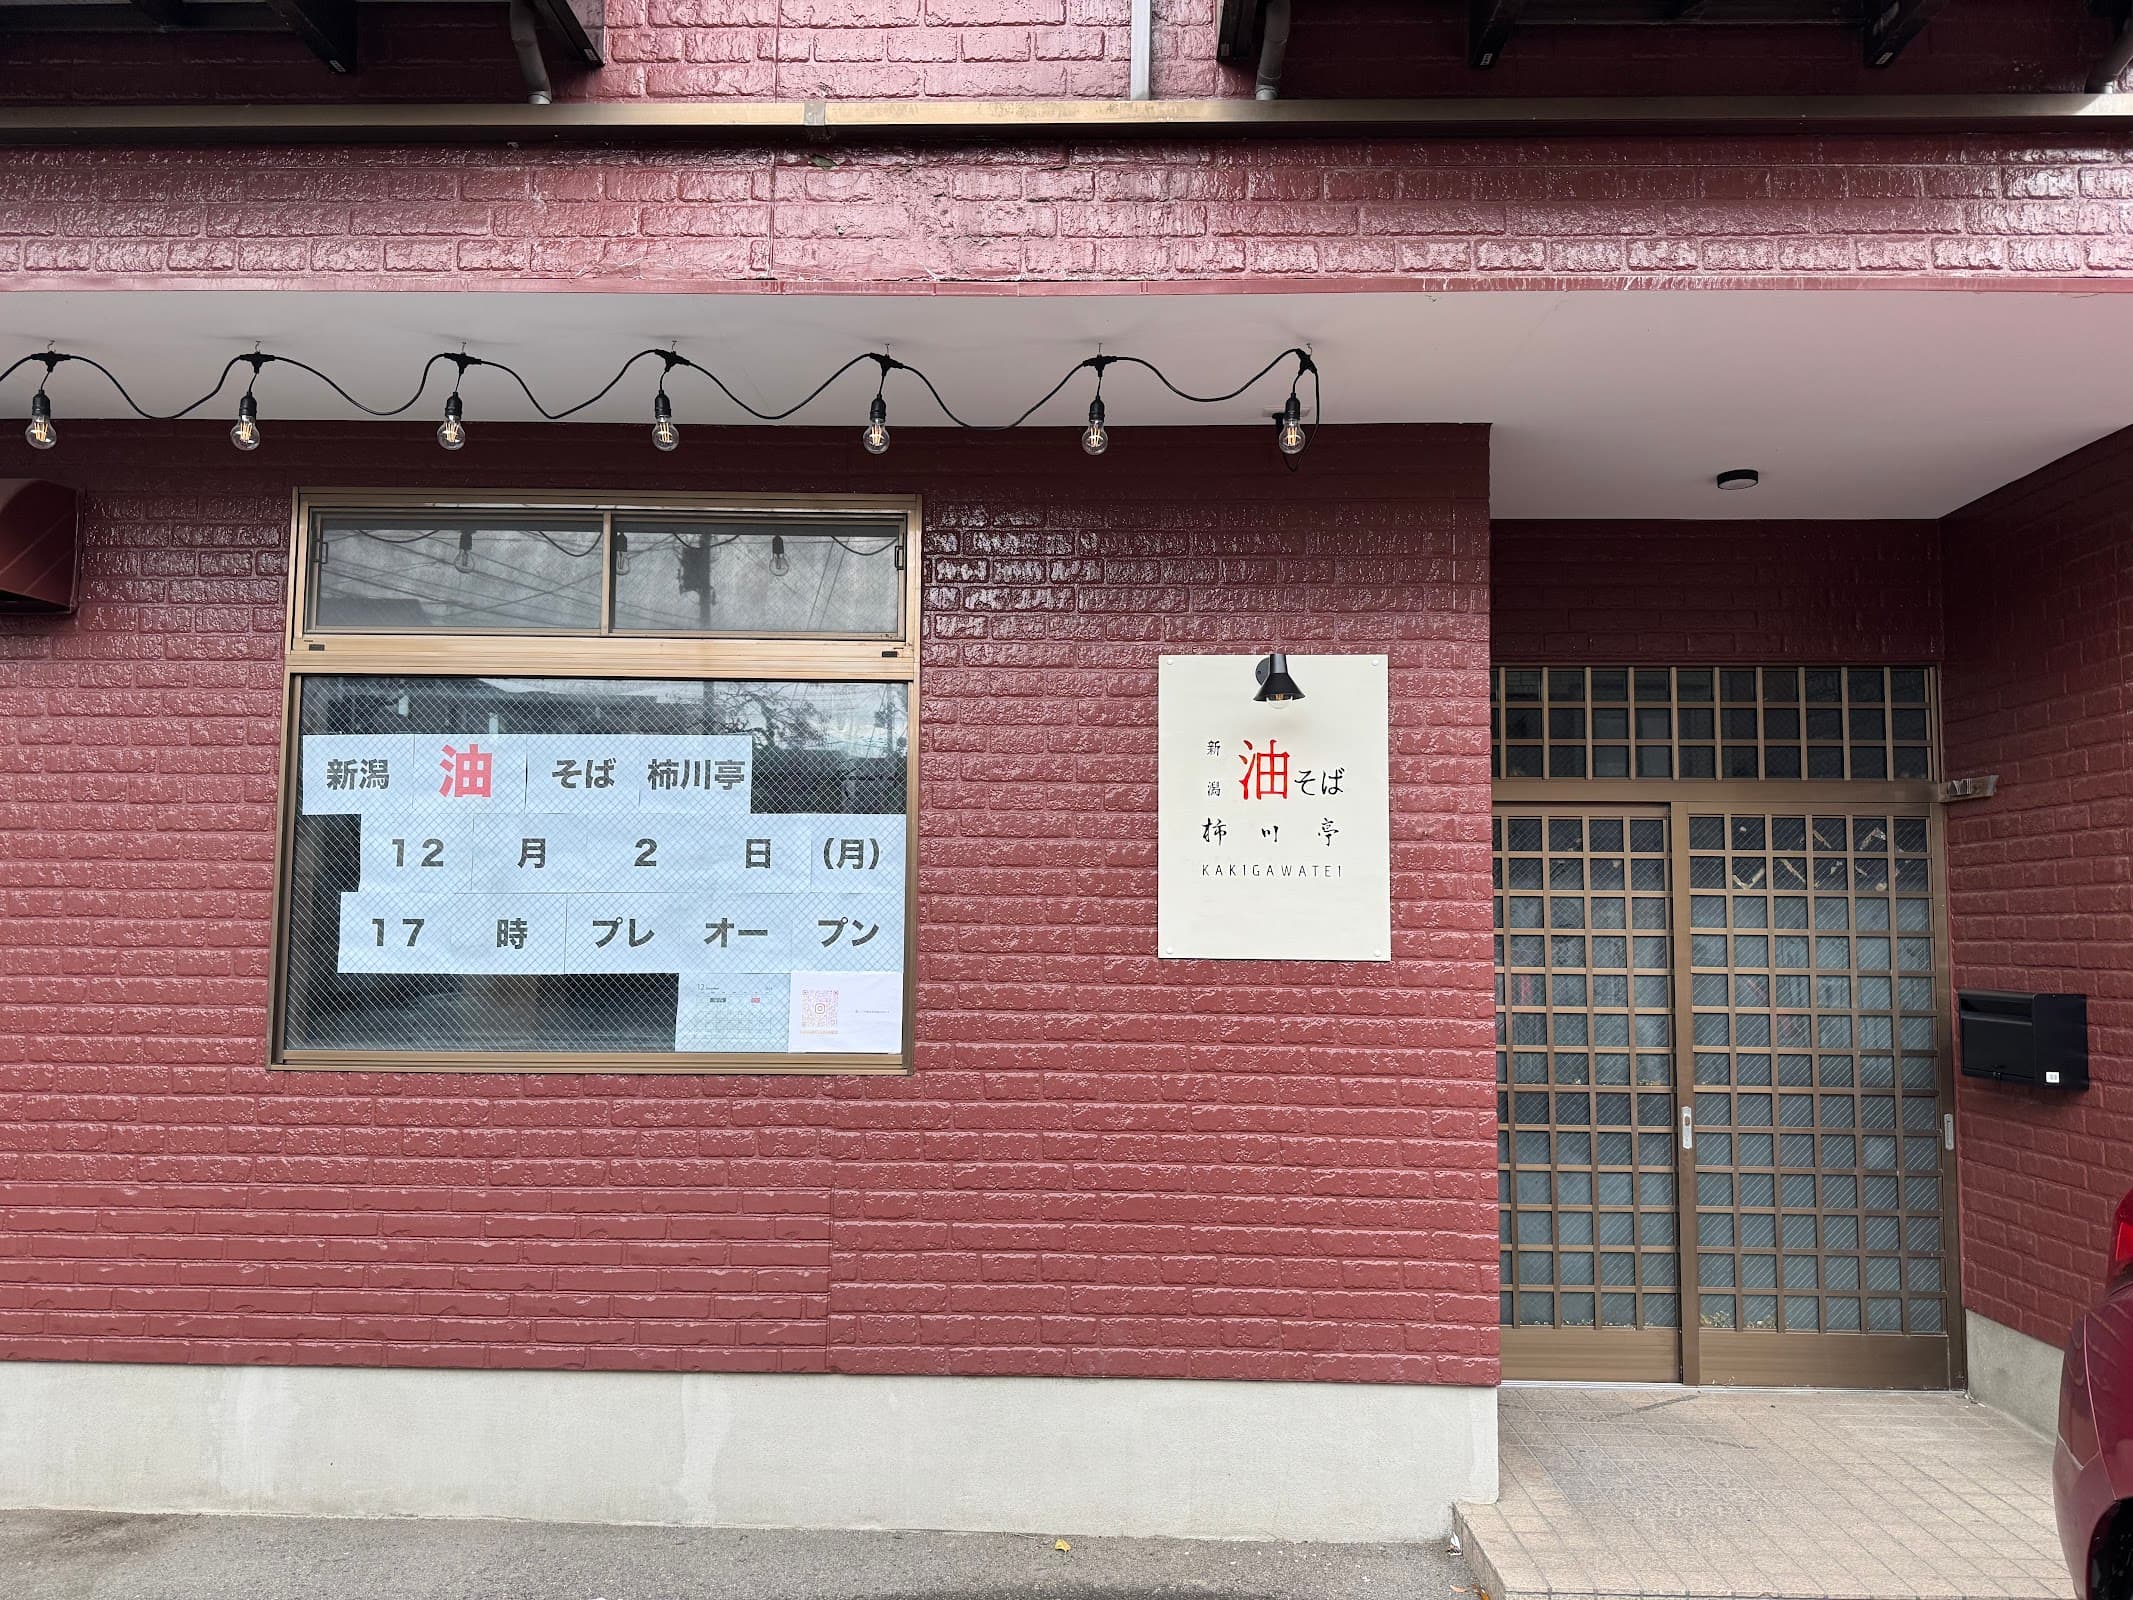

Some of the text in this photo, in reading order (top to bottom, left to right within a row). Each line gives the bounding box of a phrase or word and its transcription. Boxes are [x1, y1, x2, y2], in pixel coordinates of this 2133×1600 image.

[326, 743, 746, 798] 新潟 油 そば 柿川亭
[1206, 739, 1221, 798] 新潟
[391, 838, 444, 868] 12
[517, 838, 547, 869] 月
[634, 838, 658, 867] 2
[745, 838, 771, 869] 日
[1201, 864, 1343, 878] KAKIGAWATEI
